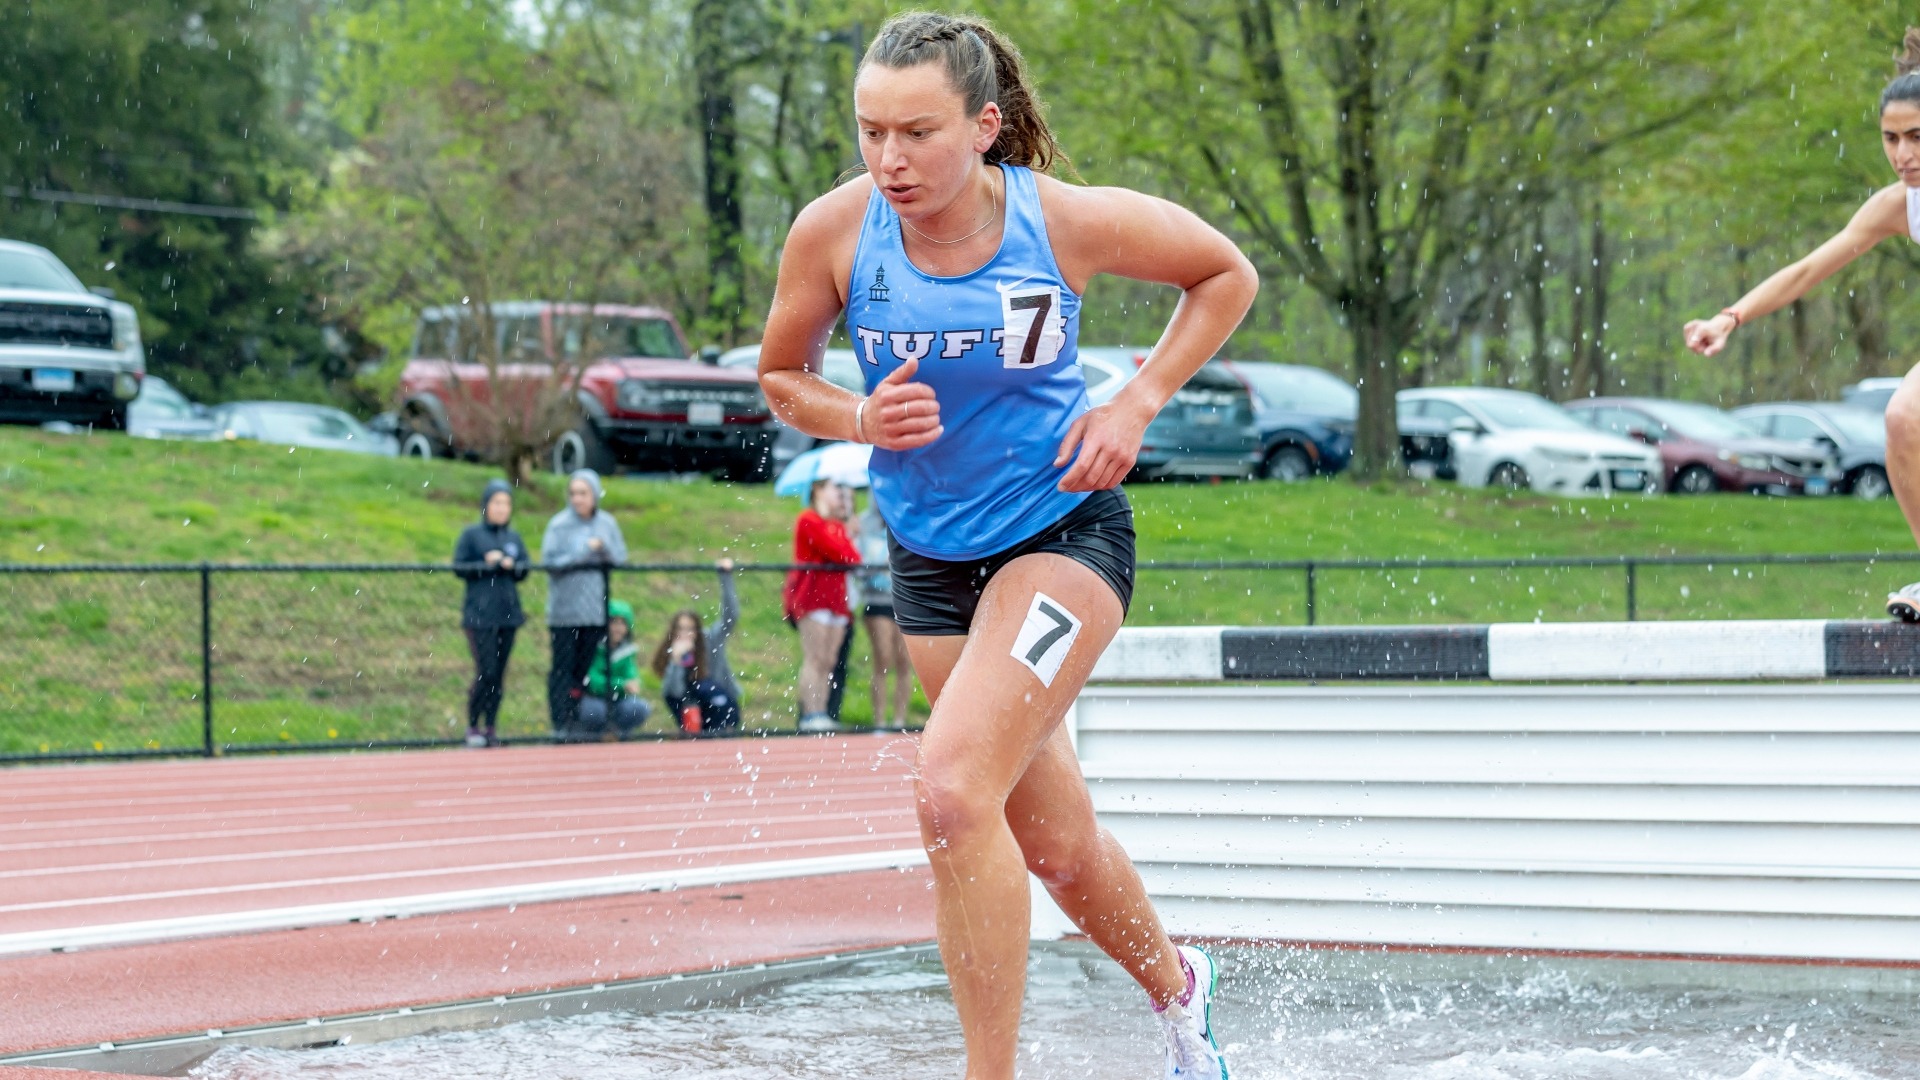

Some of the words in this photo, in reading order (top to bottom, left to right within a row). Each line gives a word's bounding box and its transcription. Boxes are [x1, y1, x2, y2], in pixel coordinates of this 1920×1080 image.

[857, 316, 1068, 366] TUF
[1009, 294, 1052, 364] 7
[1025, 601, 1073, 666] 7
